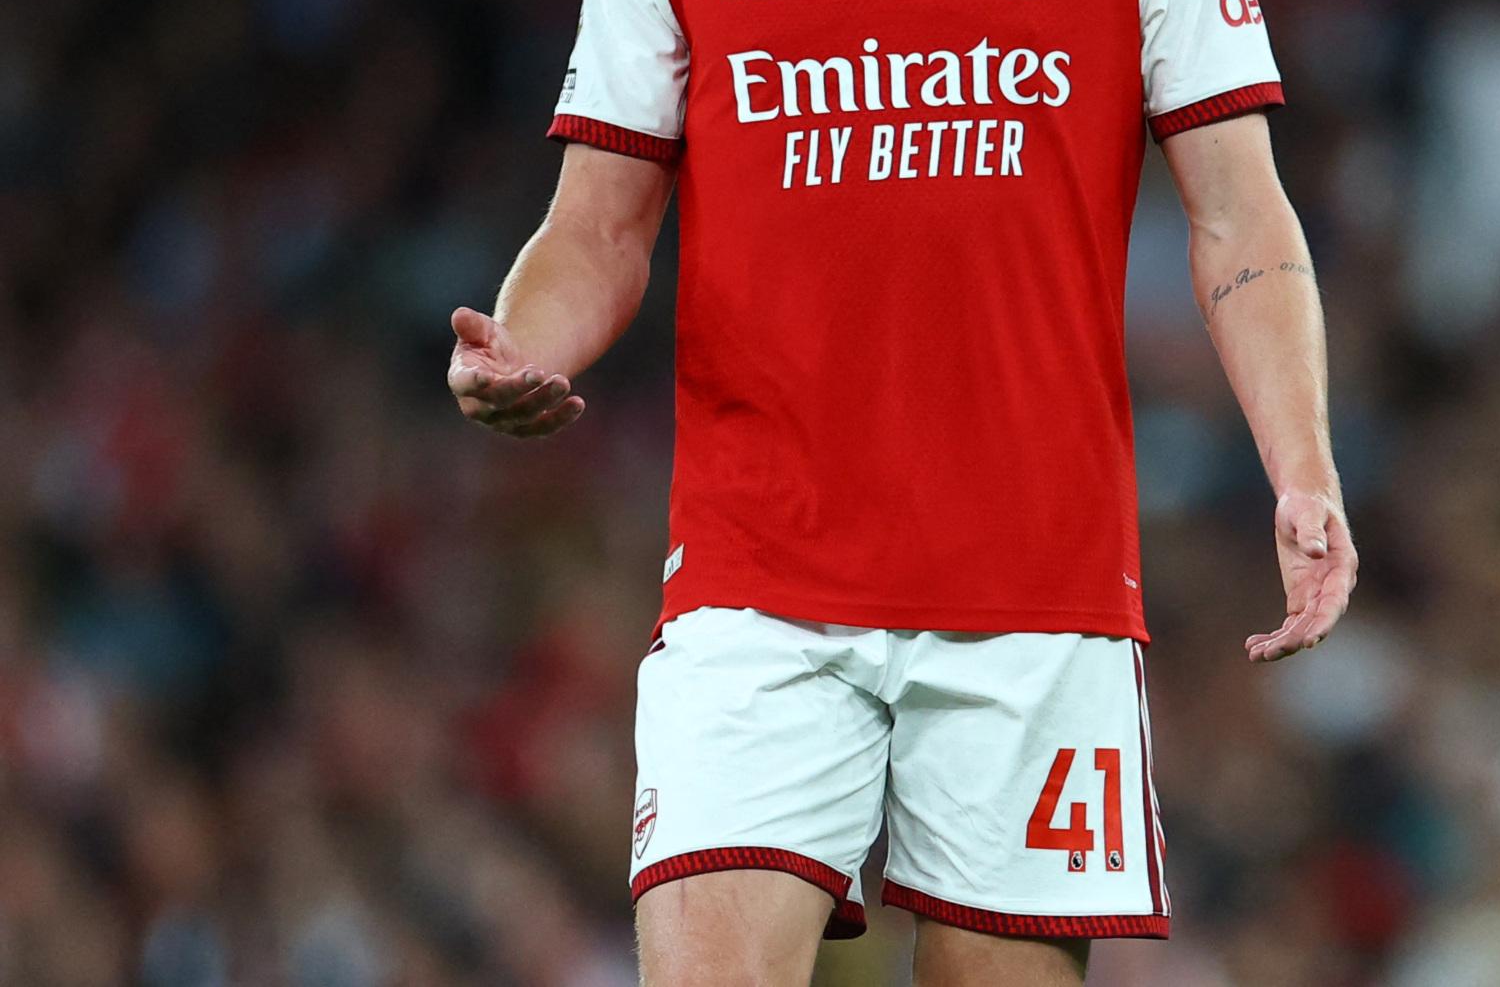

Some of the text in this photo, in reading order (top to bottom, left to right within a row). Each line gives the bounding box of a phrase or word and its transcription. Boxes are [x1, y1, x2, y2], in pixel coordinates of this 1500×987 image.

[727, 37, 1071, 123] Emirates
[782, 120, 1024, 189] FLY BETTER
[1025, 748, 1125, 872] 41
